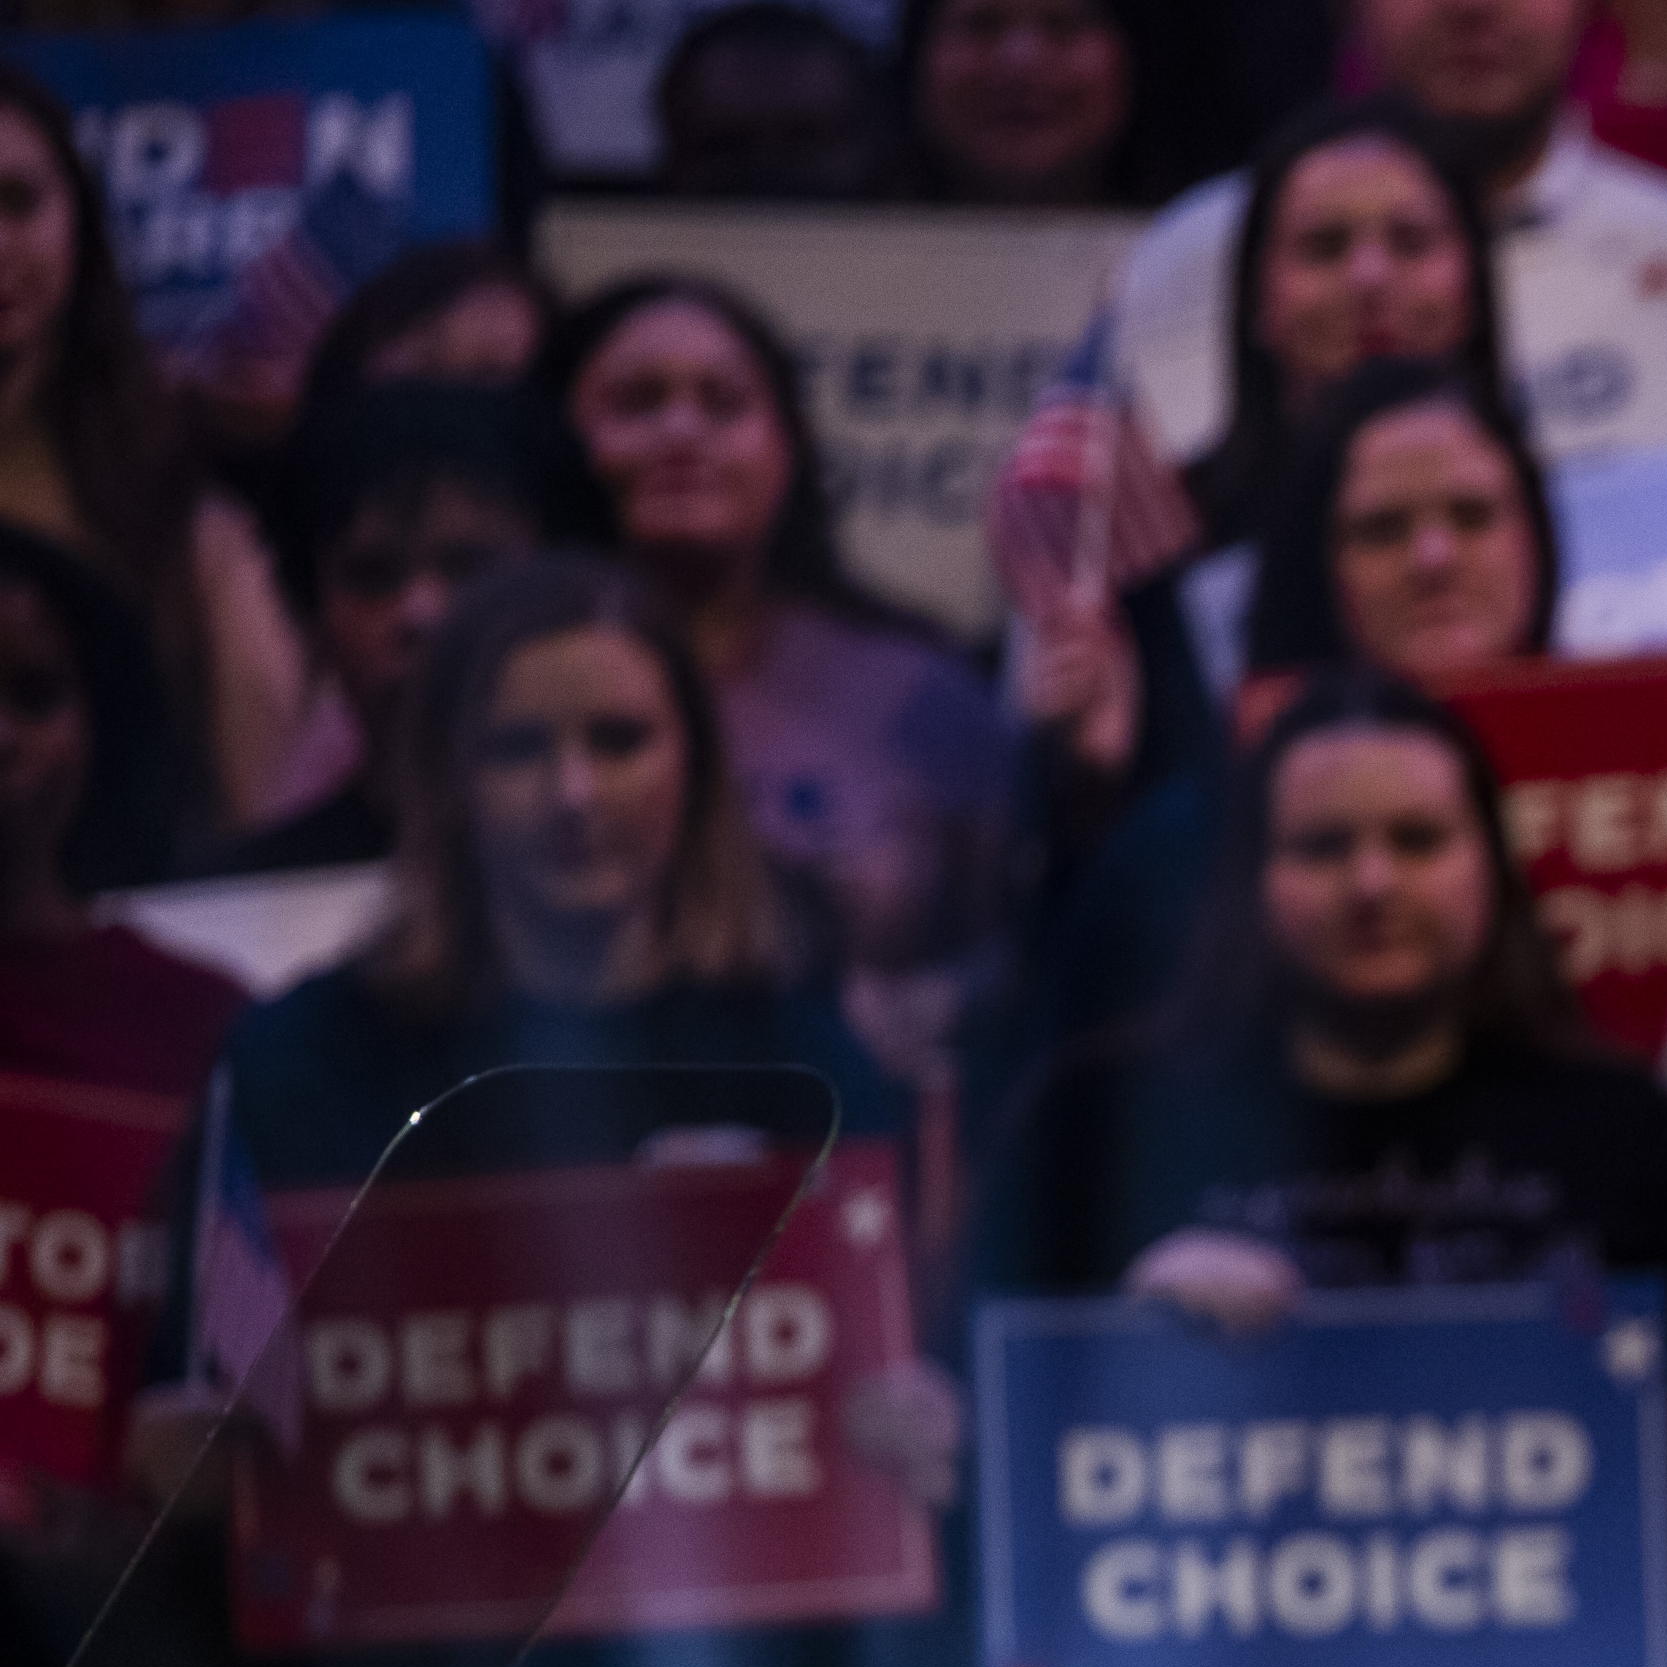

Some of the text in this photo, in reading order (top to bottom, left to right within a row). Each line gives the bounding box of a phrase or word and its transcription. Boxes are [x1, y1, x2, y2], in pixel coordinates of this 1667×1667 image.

[308, 1285, 830, 1408] DEFEND
[332, 1405, 816, 1521] CHOICE
[1059, 1409, 1595, 1528] DEFEND
[1081, 1523, 1576, 1643] CHOICE
